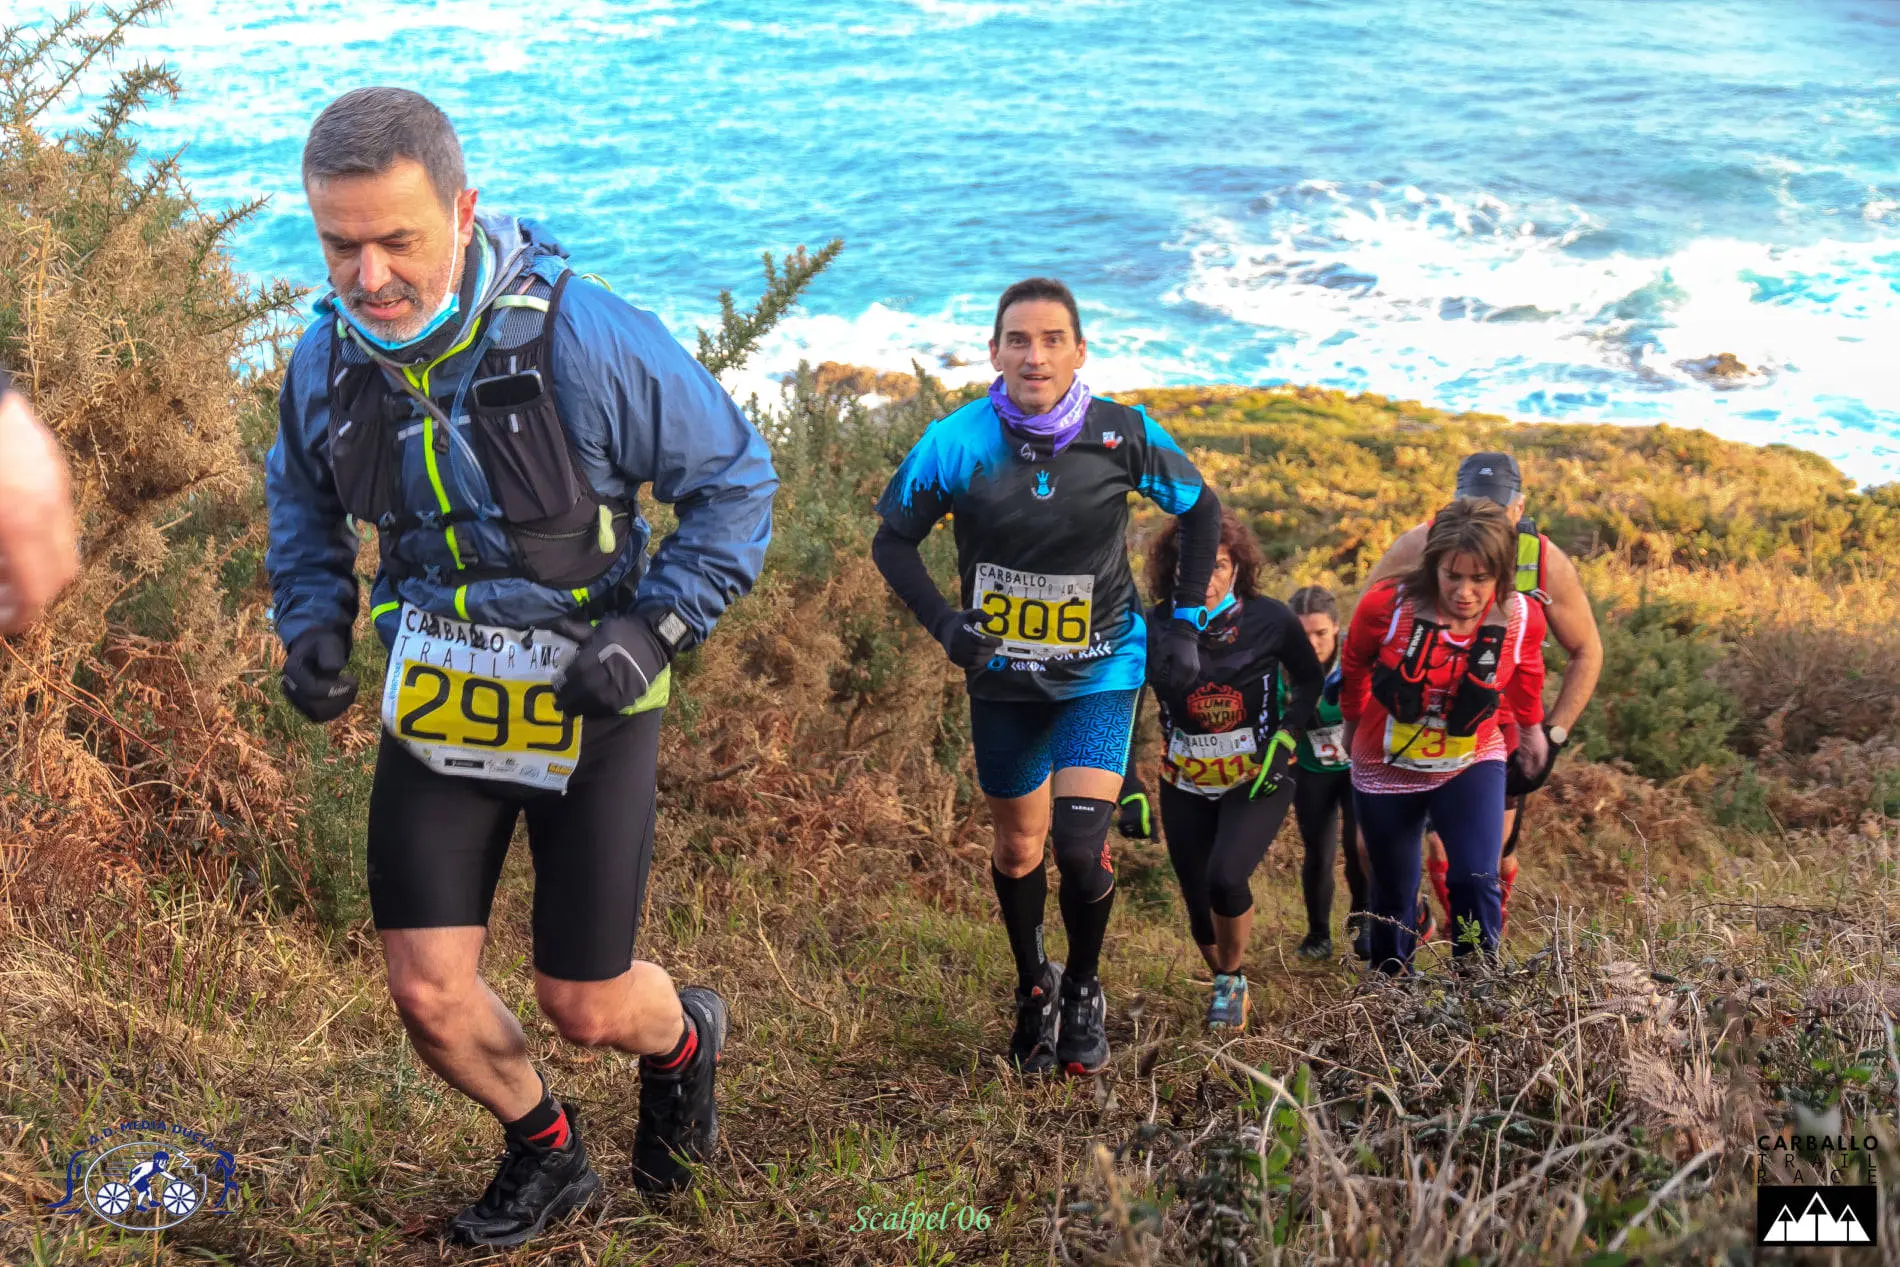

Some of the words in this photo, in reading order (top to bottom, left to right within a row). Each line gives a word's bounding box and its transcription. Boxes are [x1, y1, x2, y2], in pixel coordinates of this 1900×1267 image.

[979, 565, 1047, 588] CARBALLO
[981, 593, 1086, 643] 306
[400, 635, 501, 679] TRAIL
[400, 664, 574, 752] 299
[1421, 727, 1448, 758] 3
[1184, 755, 1245, 786] 211
